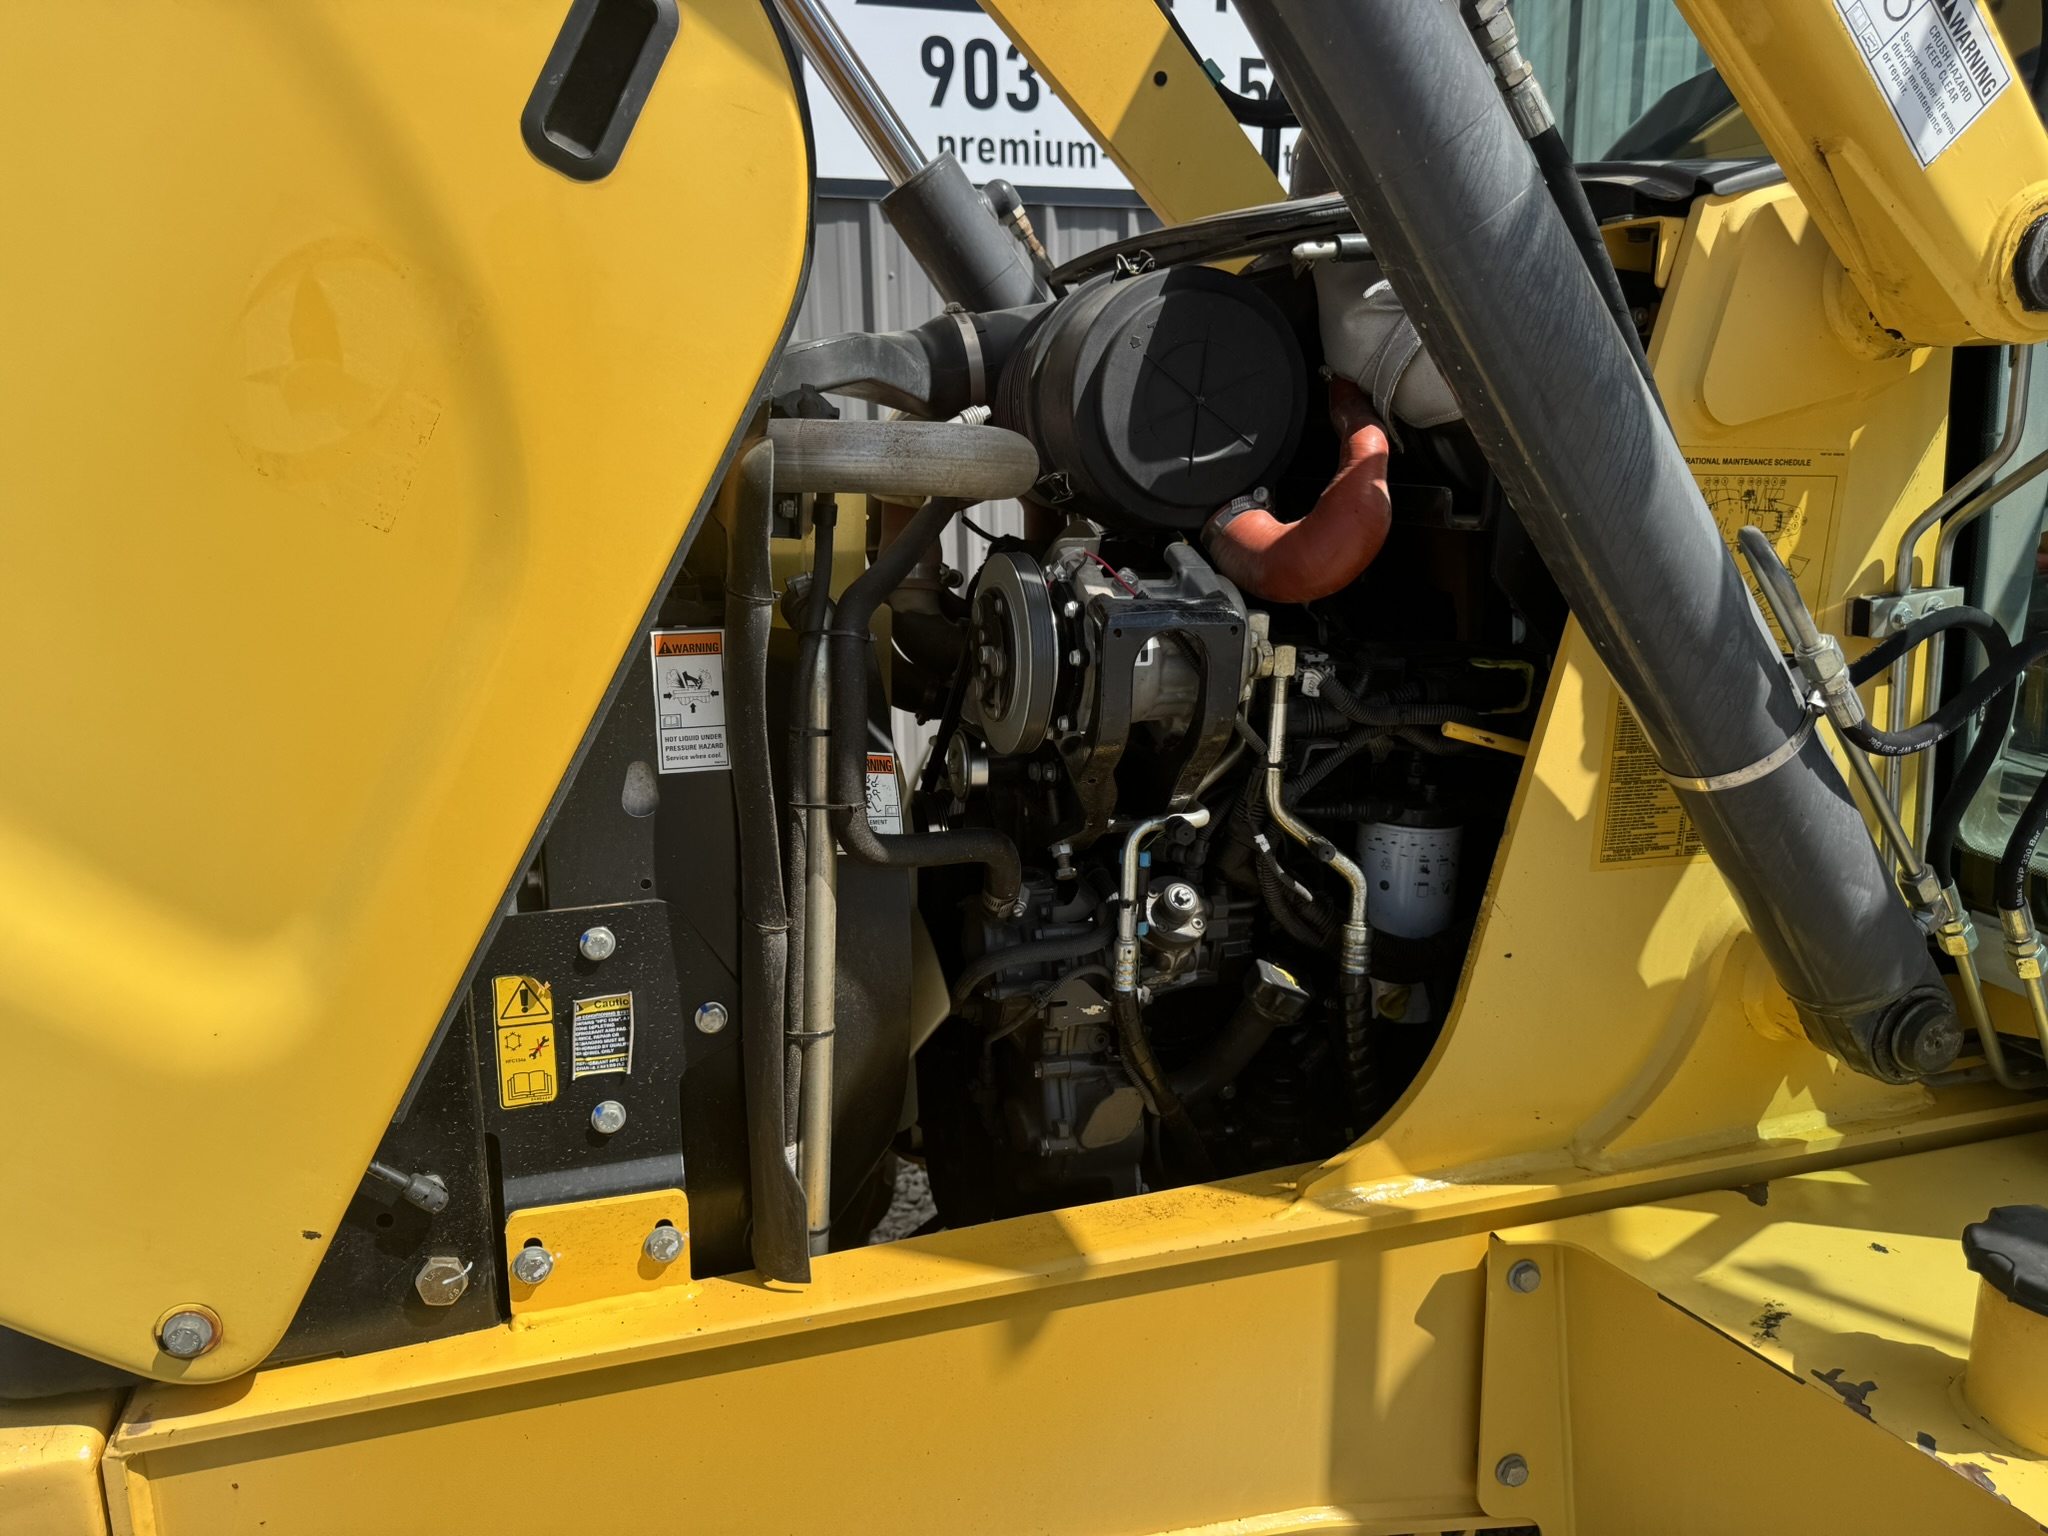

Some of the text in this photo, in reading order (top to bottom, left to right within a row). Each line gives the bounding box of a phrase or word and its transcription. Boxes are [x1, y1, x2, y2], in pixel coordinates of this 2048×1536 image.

[1882, 52, 1909, 97] or repair.
[1924, 42, 1959, 104] KEEP CLEAR
[1928, 24, 1972, 103] CRUSH HAZARD
[1948, 11, 1997, 98] WARNING
[1890, 42, 1943, 136] during maintenance
[1900, 31, 1957, 135] Support loader lift arms
[1683, 457, 1812, 467] RATIONAL MAINTENANCE SCHEDULE
[672, 642, 719, 654] WARNING
[664, 733, 723, 743] HOT LIQUID UNDER
[665, 742, 724, 752] PRESSURE HAZARD
[665, 754, 689, 762] Service
[867, 758, 893, 772] RNING
[2015, 829, 2042, 906] Max. WP 330 Bar
